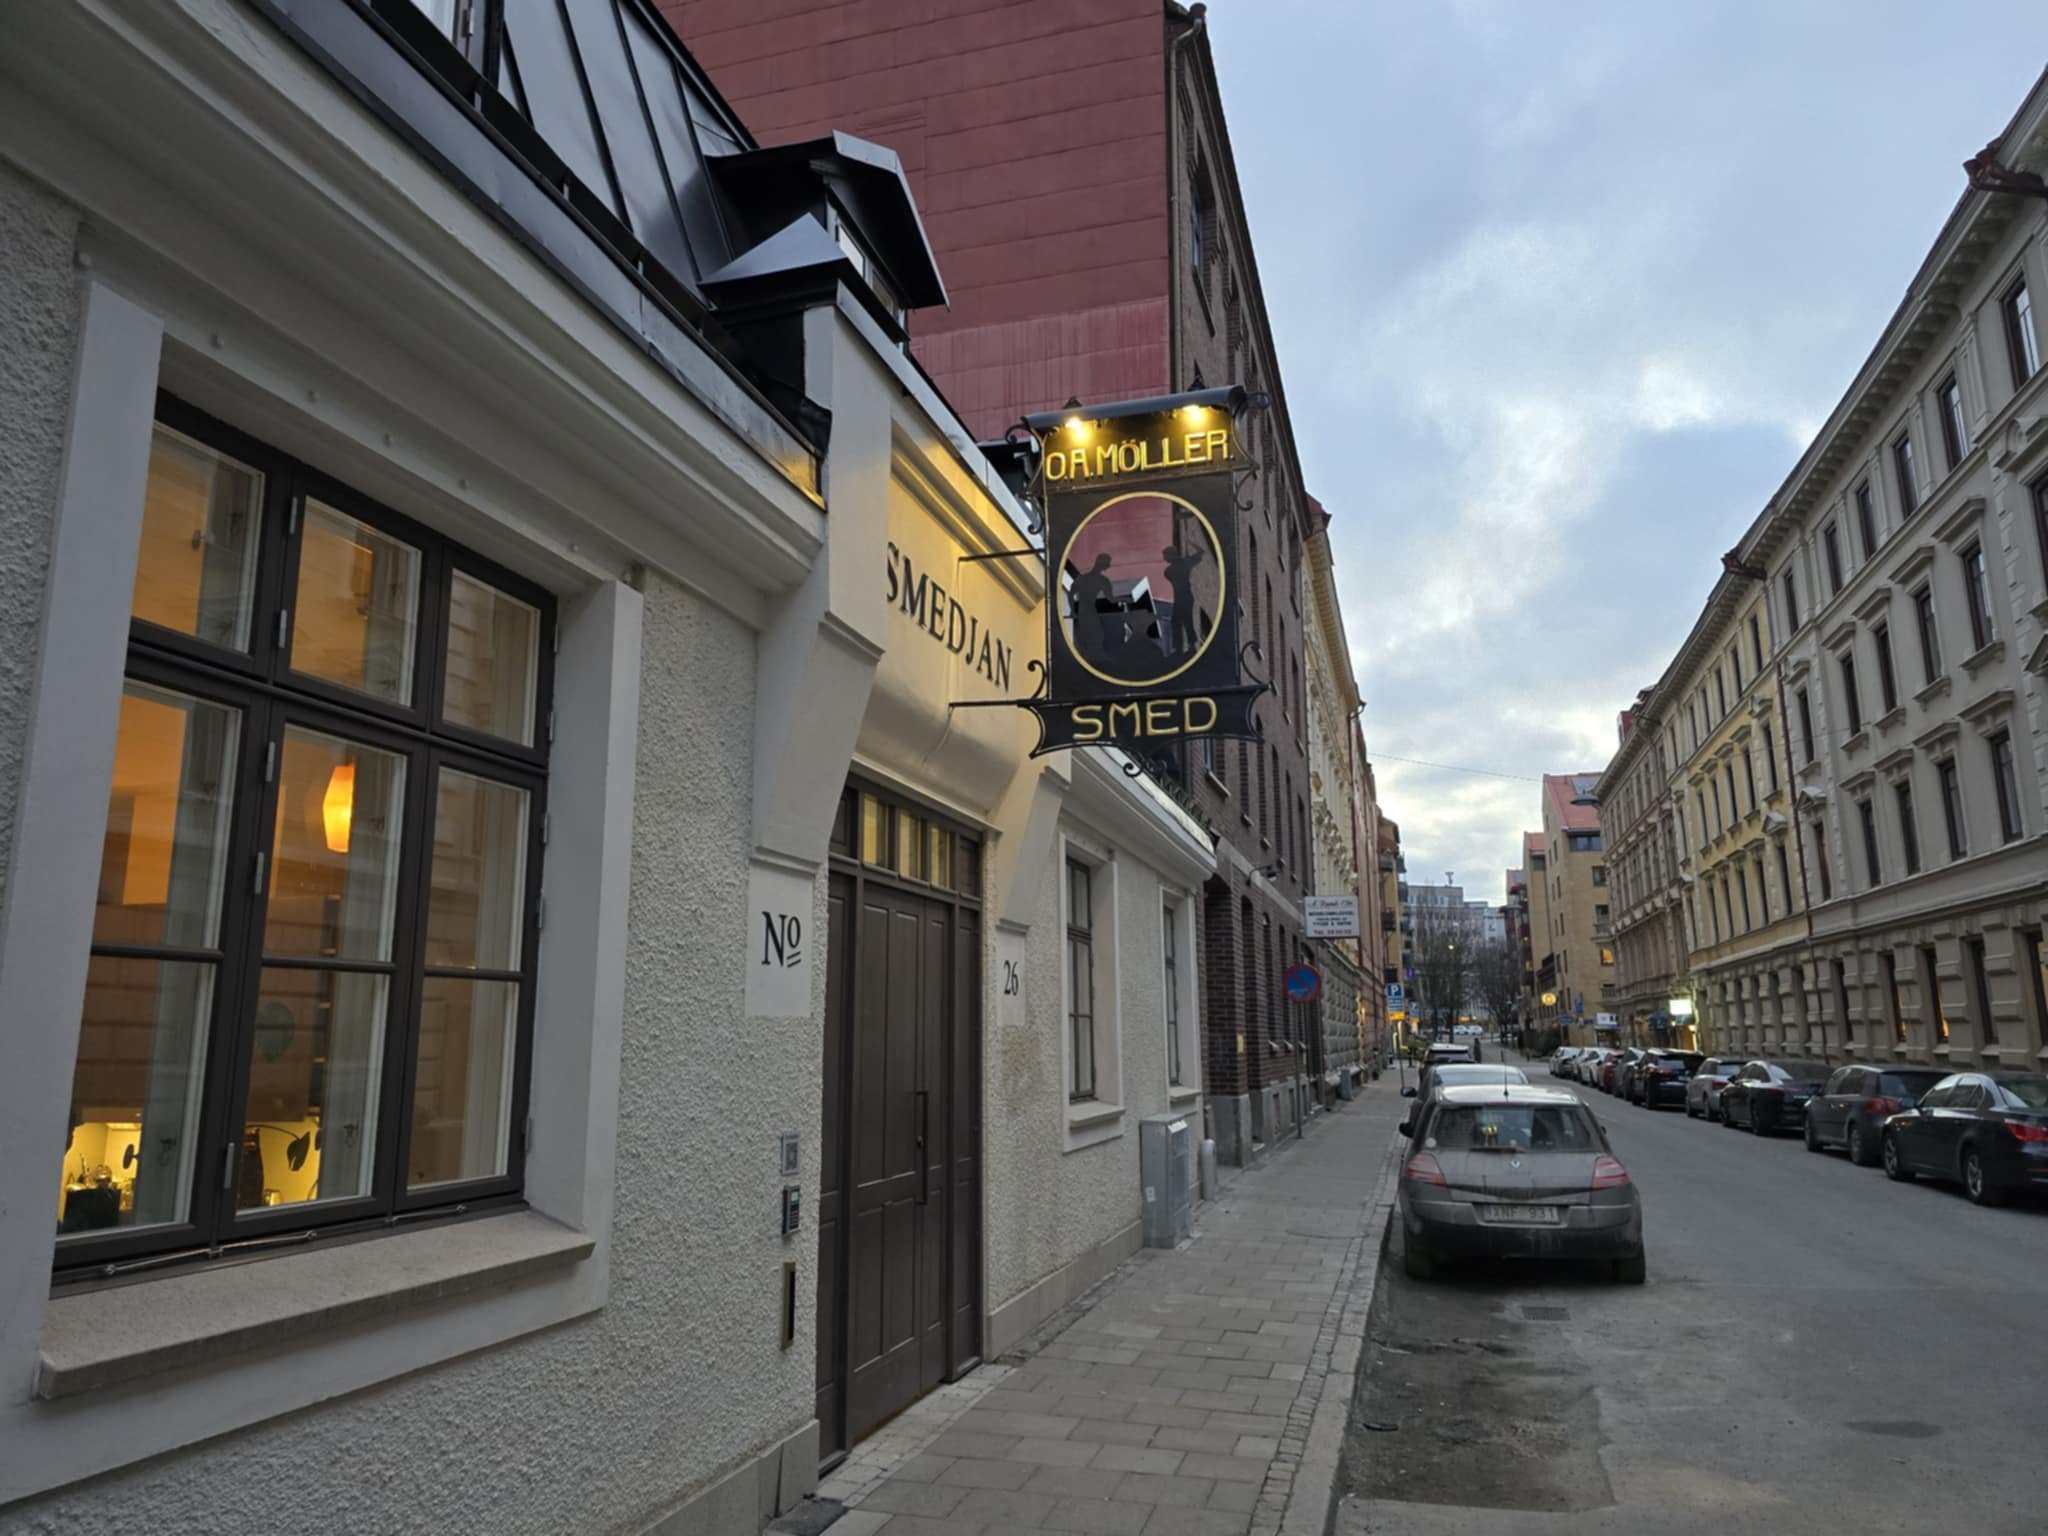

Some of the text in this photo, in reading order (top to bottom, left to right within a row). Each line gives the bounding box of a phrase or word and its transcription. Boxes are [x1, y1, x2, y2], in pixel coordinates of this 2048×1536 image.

[886, 541, 1013, 694] SMEDJAN
[1071, 697, 1218, 740] SMED
[1003, 959, 1019, 997] 26
